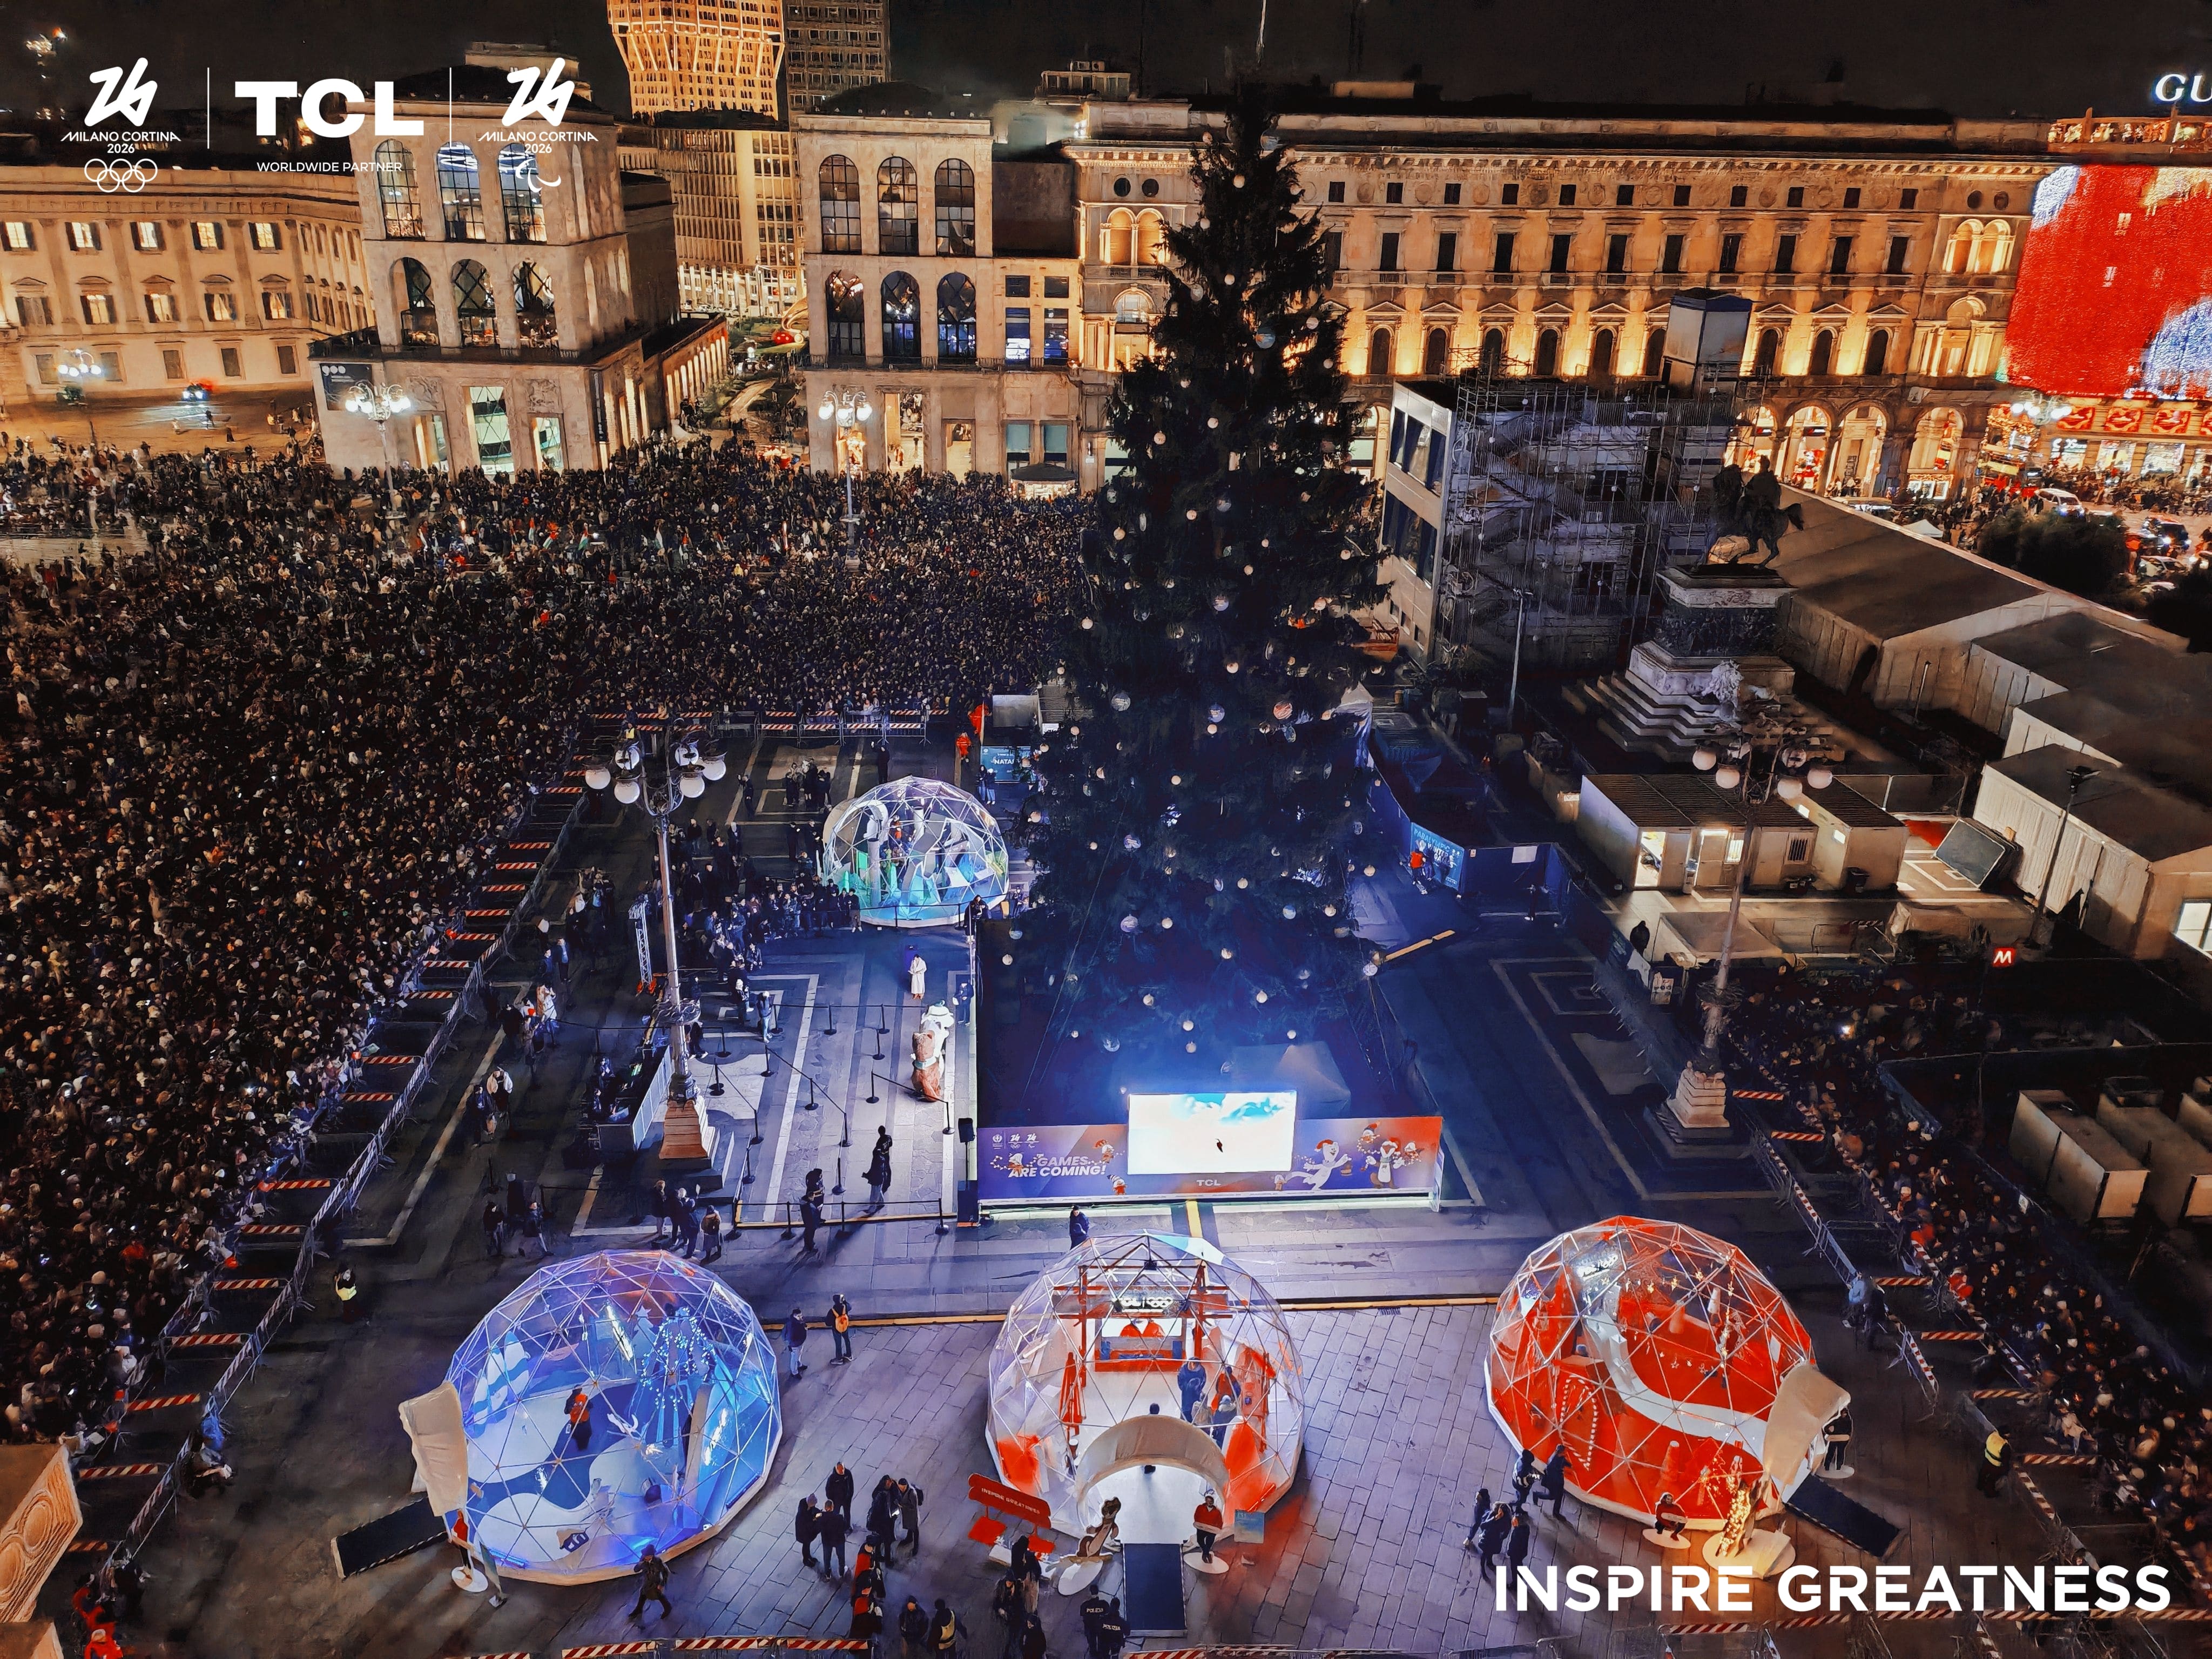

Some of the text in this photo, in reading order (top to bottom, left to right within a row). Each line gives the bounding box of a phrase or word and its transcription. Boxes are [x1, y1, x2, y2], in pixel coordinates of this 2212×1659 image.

[1993, 950, 2012, 964] M
[1008, 1165, 1107, 1177] ARE COMING!
